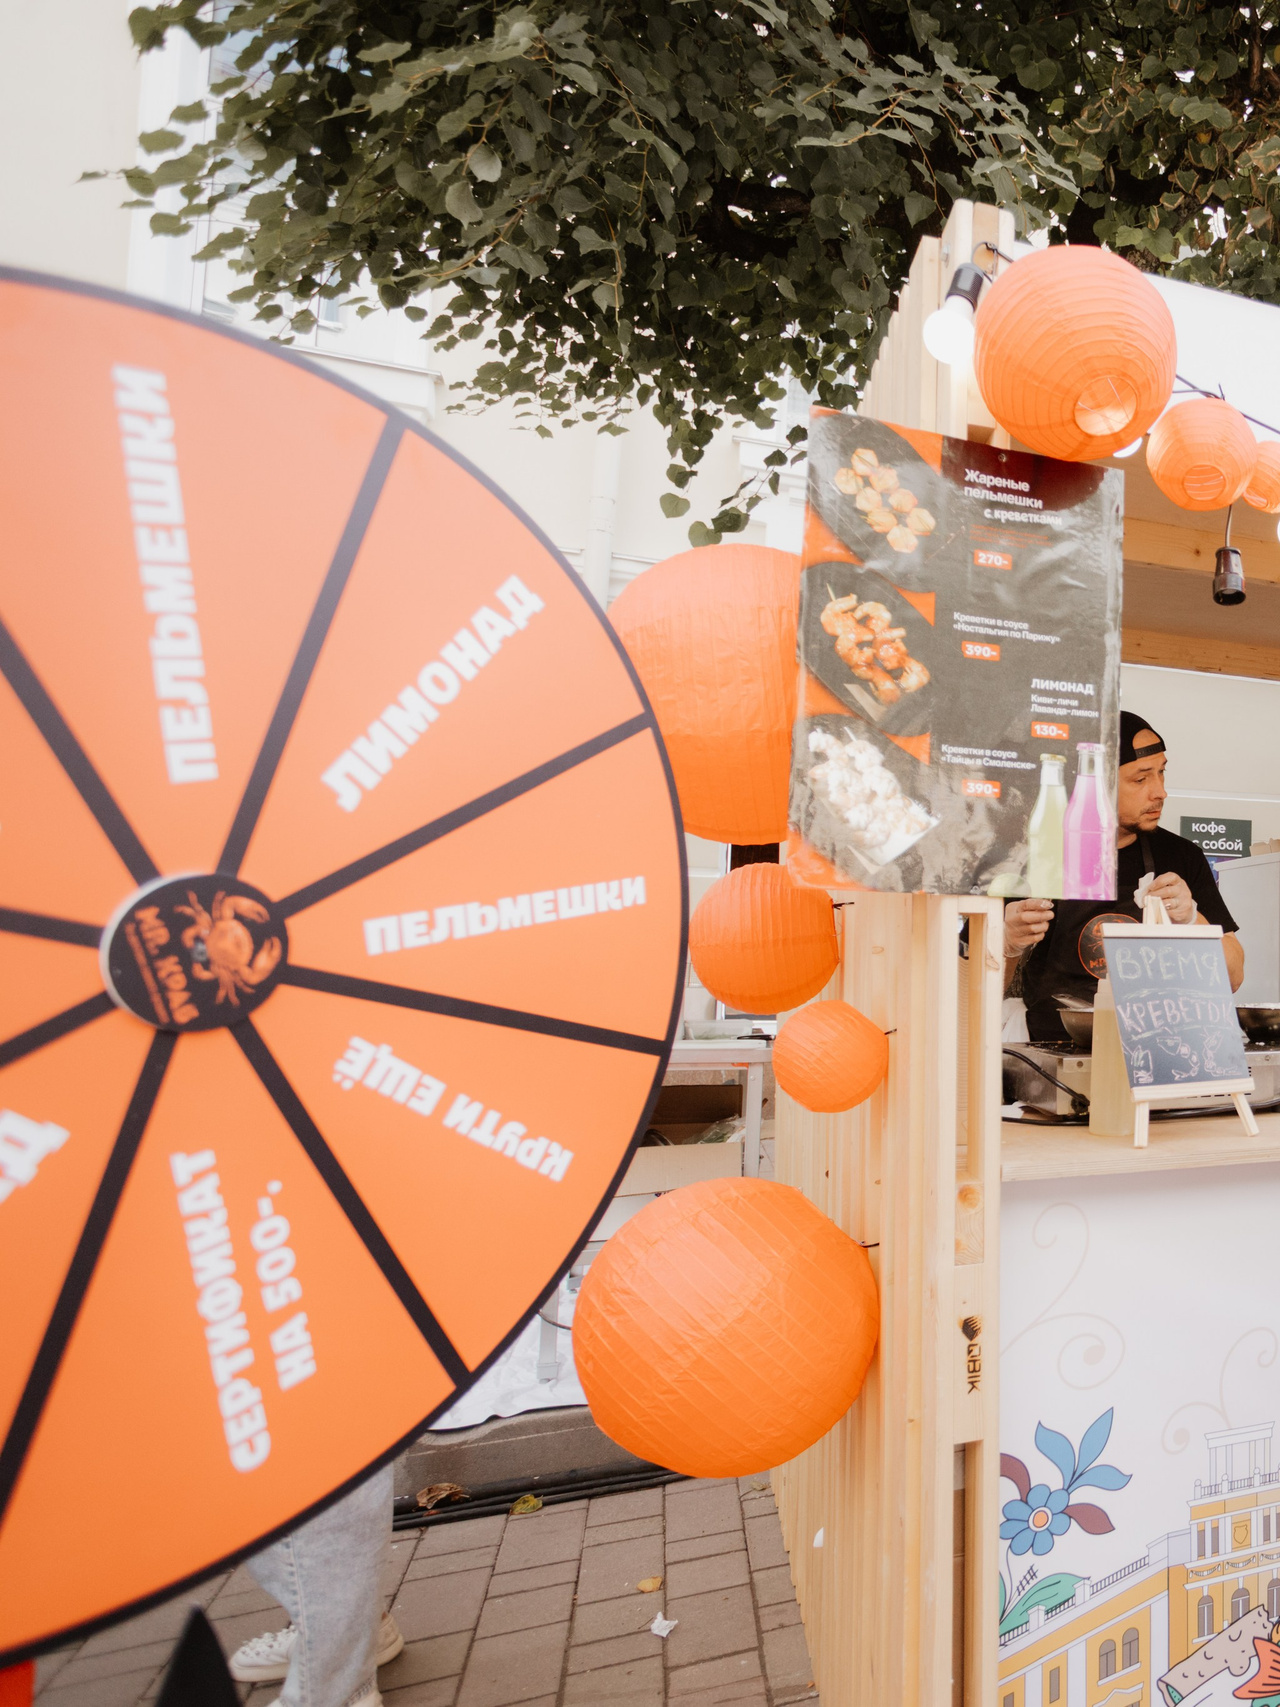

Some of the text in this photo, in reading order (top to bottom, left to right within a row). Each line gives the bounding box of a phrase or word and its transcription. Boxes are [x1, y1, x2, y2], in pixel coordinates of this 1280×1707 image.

[964, 468, 1030, 492] Жареные
[964, 486, 1043, 509] пельмешки
[984, 508, 1062, 525] с креветками
[110, 361, 219, 784] ПЕЛЬМЕШКИ
[953, 612, 995, 626] Креветки
[1003, 620, 1029, 630] соусе
[1010, 631, 1021, 639] по
[321, 574, 546, 812] ЛИМОНАД
[1031, 678, 1095, 696] ЛИМОНАД
[1031, 704, 1099, 718] Лаванда-лимон
[941, 744, 985, 757] Креветки
[991, 750, 1018, 760] соусе
[1191, 821, 1226, 835] кофе
[1202, 838, 1243, 851] собой
[363, 876, 646, 955] ПЕЛЬМЕШКИ
[1115, 946, 1221, 986] ВРЕМЯ
[332, 1036, 574, 1182] КРУТИ ЕЩЁ
[170, 1149, 272, 1472] СЕРТИФИКАТ
[268, 1313, 317, 1390] НА
[967, 1343, 982, 1395] QBIK
